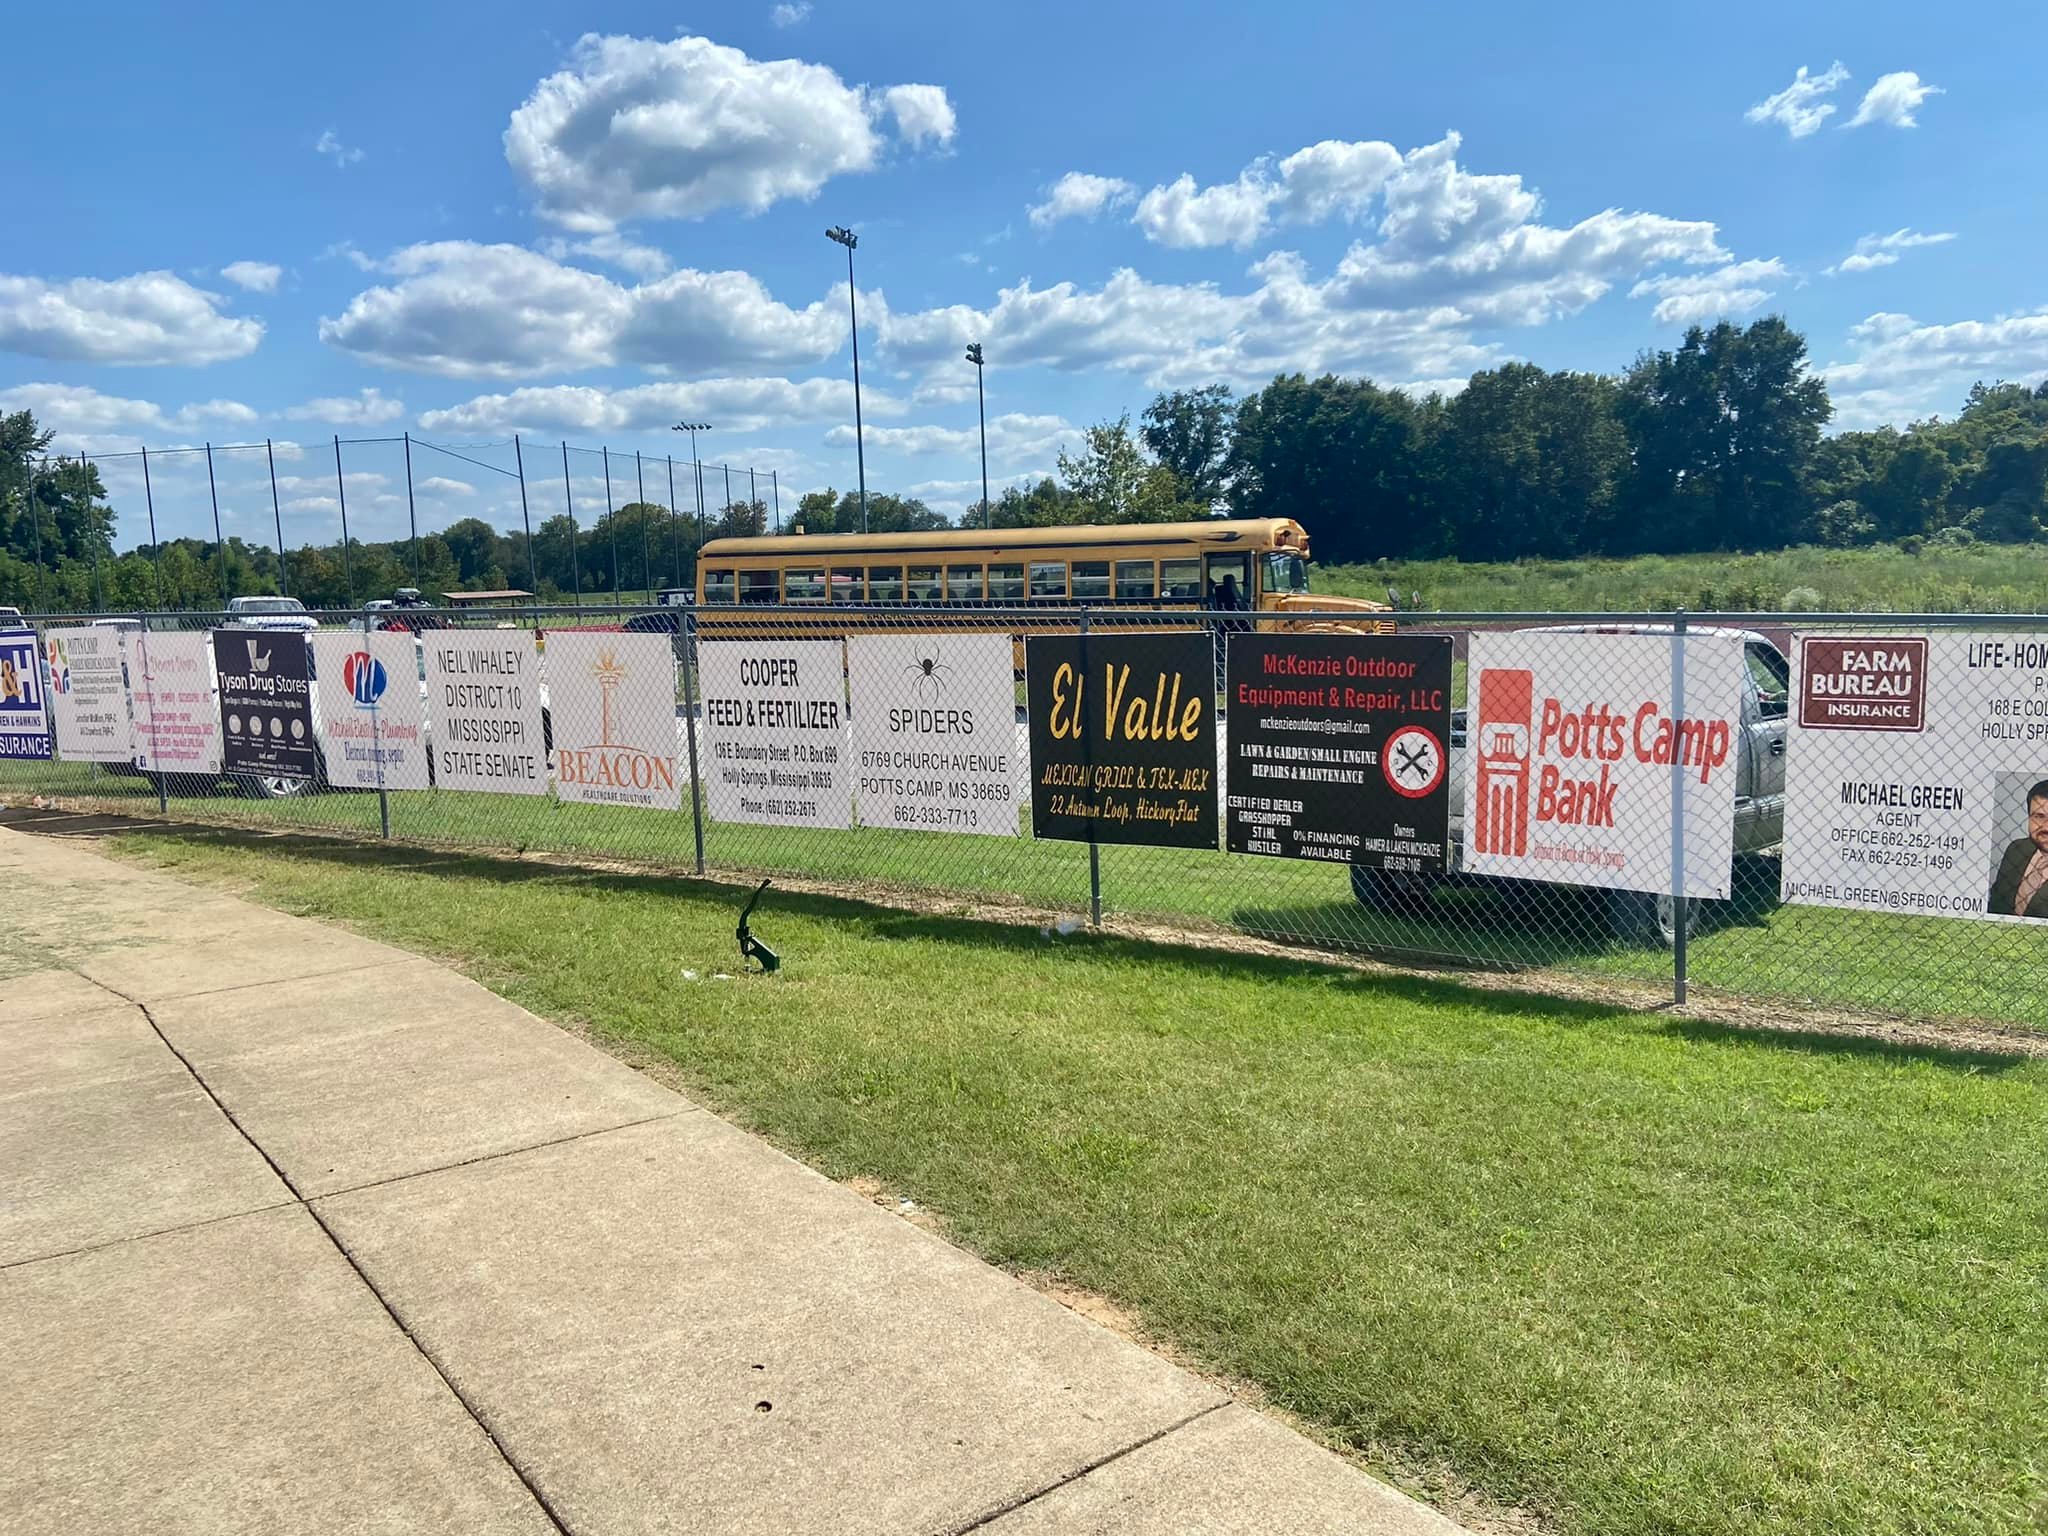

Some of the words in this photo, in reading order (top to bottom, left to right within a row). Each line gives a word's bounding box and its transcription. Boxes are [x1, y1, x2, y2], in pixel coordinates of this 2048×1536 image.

[438, 650, 467, 673] NEIL
[467, 650, 523, 674] WHALEY
[1263, 654, 1341, 676] McKenzie
[1346, 655, 1416, 678] Outdoor
[1842, 650, 1912, 672] FARM
[740, 658, 799, 687] COOPER
[219, 672, 248, 693] Tyson
[249, 673, 275, 696] Drug
[276, 674, 307, 694] Stores
[1811, 674, 1913, 696] BUREAU
[445, 684, 503, 709] DISTRICT
[507, 686, 522, 710] 10
[1050, 662, 1084, 740] El
[1105, 663, 1202, 742] Valle
[1239, 684, 1324, 709] Equipment
[1329, 687, 1340, 708] &
[1344, 688, 1406, 714] Repair,
[1411, 689, 1442, 711] LLC
[1989, 699, 2010, 716] 168
[2013, 700, 2021, 715] E
[708, 699, 743, 726] FEED
[747, 700, 755, 727] &
[759, 700, 840, 729] FERTILIZER
[889, 709, 974, 734] SPIDERS
[1828, 704, 1911, 718] INSURANCE
[448, 718, 525, 744] MISSISSIPPI
[1260, 717, 1371, 735] mckenzieoutdoors@gmail.com
[1982, 722, 2024, 739] HOLLY
[1538, 698, 1626, 761] Potts
[1633, 701, 1729, 784] Camp
[735, 742, 768, 765] Boundary
[769, 744, 790, 761] Street
[793, 745, 809, 762] P.O.
[809, 745, 824, 763] Box
[861, 751, 891, 768] 6769
[893, 752, 949, 770] CHURCH
[951, 754, 1007, 773] AVENUE
[1240, 744, 1265, 758] LAWN
[1266, 745, 1272, 758] &
[1343, 749, 1377, 765] ENGINE
[443, 751, 483, 776] STATE
[485, 754, 536, 779] SENATE
[558, 749, 675, 791] BEACON
[1252, 764, 1290, 779] REPAIRS
[1291, 766, 1298, 779] &
[1299, 767, 1364, 784] MAINTENANCE
[722, 766, 740, 788] Holly
[770, 769, 811, 792] Mississippi
[861, 778, 903, 795] POTTS
[906, 779, 946, 800] CAMP,
[950, 782, 968, 799] MS
[971, 783, 1010, 801] 38659
[1041, 764, 1093, 788] MEXICAN
[1094, 766, 1134, 793] GRILL
[1137, 767, 1146, 789] &
[1149, 767, 1210, 792] TEX-MEX
[583, 789, 618, 801] HEALTHCARE
[620, 792, 652, 804] SOLUTIONS
[1228, 796, 1271, 810] CERTIFIED
[1273, 798, 1303, 813] DEALER
[1536, 764, 1618, 828] Bank
[1842, 782, 1907, 807] MICHAEL
[1911, 786, 1963, 810] GREEN
[765, 799, 784, 817] (662)
[784, 800, 817, 817] 252-2675
[894, 805, 977, 827] 662-333-7713
[1050, 794, 1064, 815] 22
[1065, 794, 1100, 818] Autumn
[1103, 796, 1133, 825] Loop,
[1238, 811, 1292, 826] GRASSHOPPER
[1393, 823, 1415, 838] Owners
[1876, 813, 1921, 827] AGENT
[1252, 826, 1277, 840] STIHL
[1293, 830, 1306, 842] 0%
[1307, 831, 1360, 846] FINANCING
[1831, 828, 1878, 844] OFFICE
[1881, 834, 1965, 850] 662-252-1491
[1247, 841, 1281, 854] HUSTLER
[1300, 846, 1352, 861] AVAILABLE
[1842, 848, 1865, 862] FAX
[1869, 852, 1953, 869] 662-252-1496
[1786, 882, 1983, 912] MICHAEL.GREEN@SFBCIC.COM
